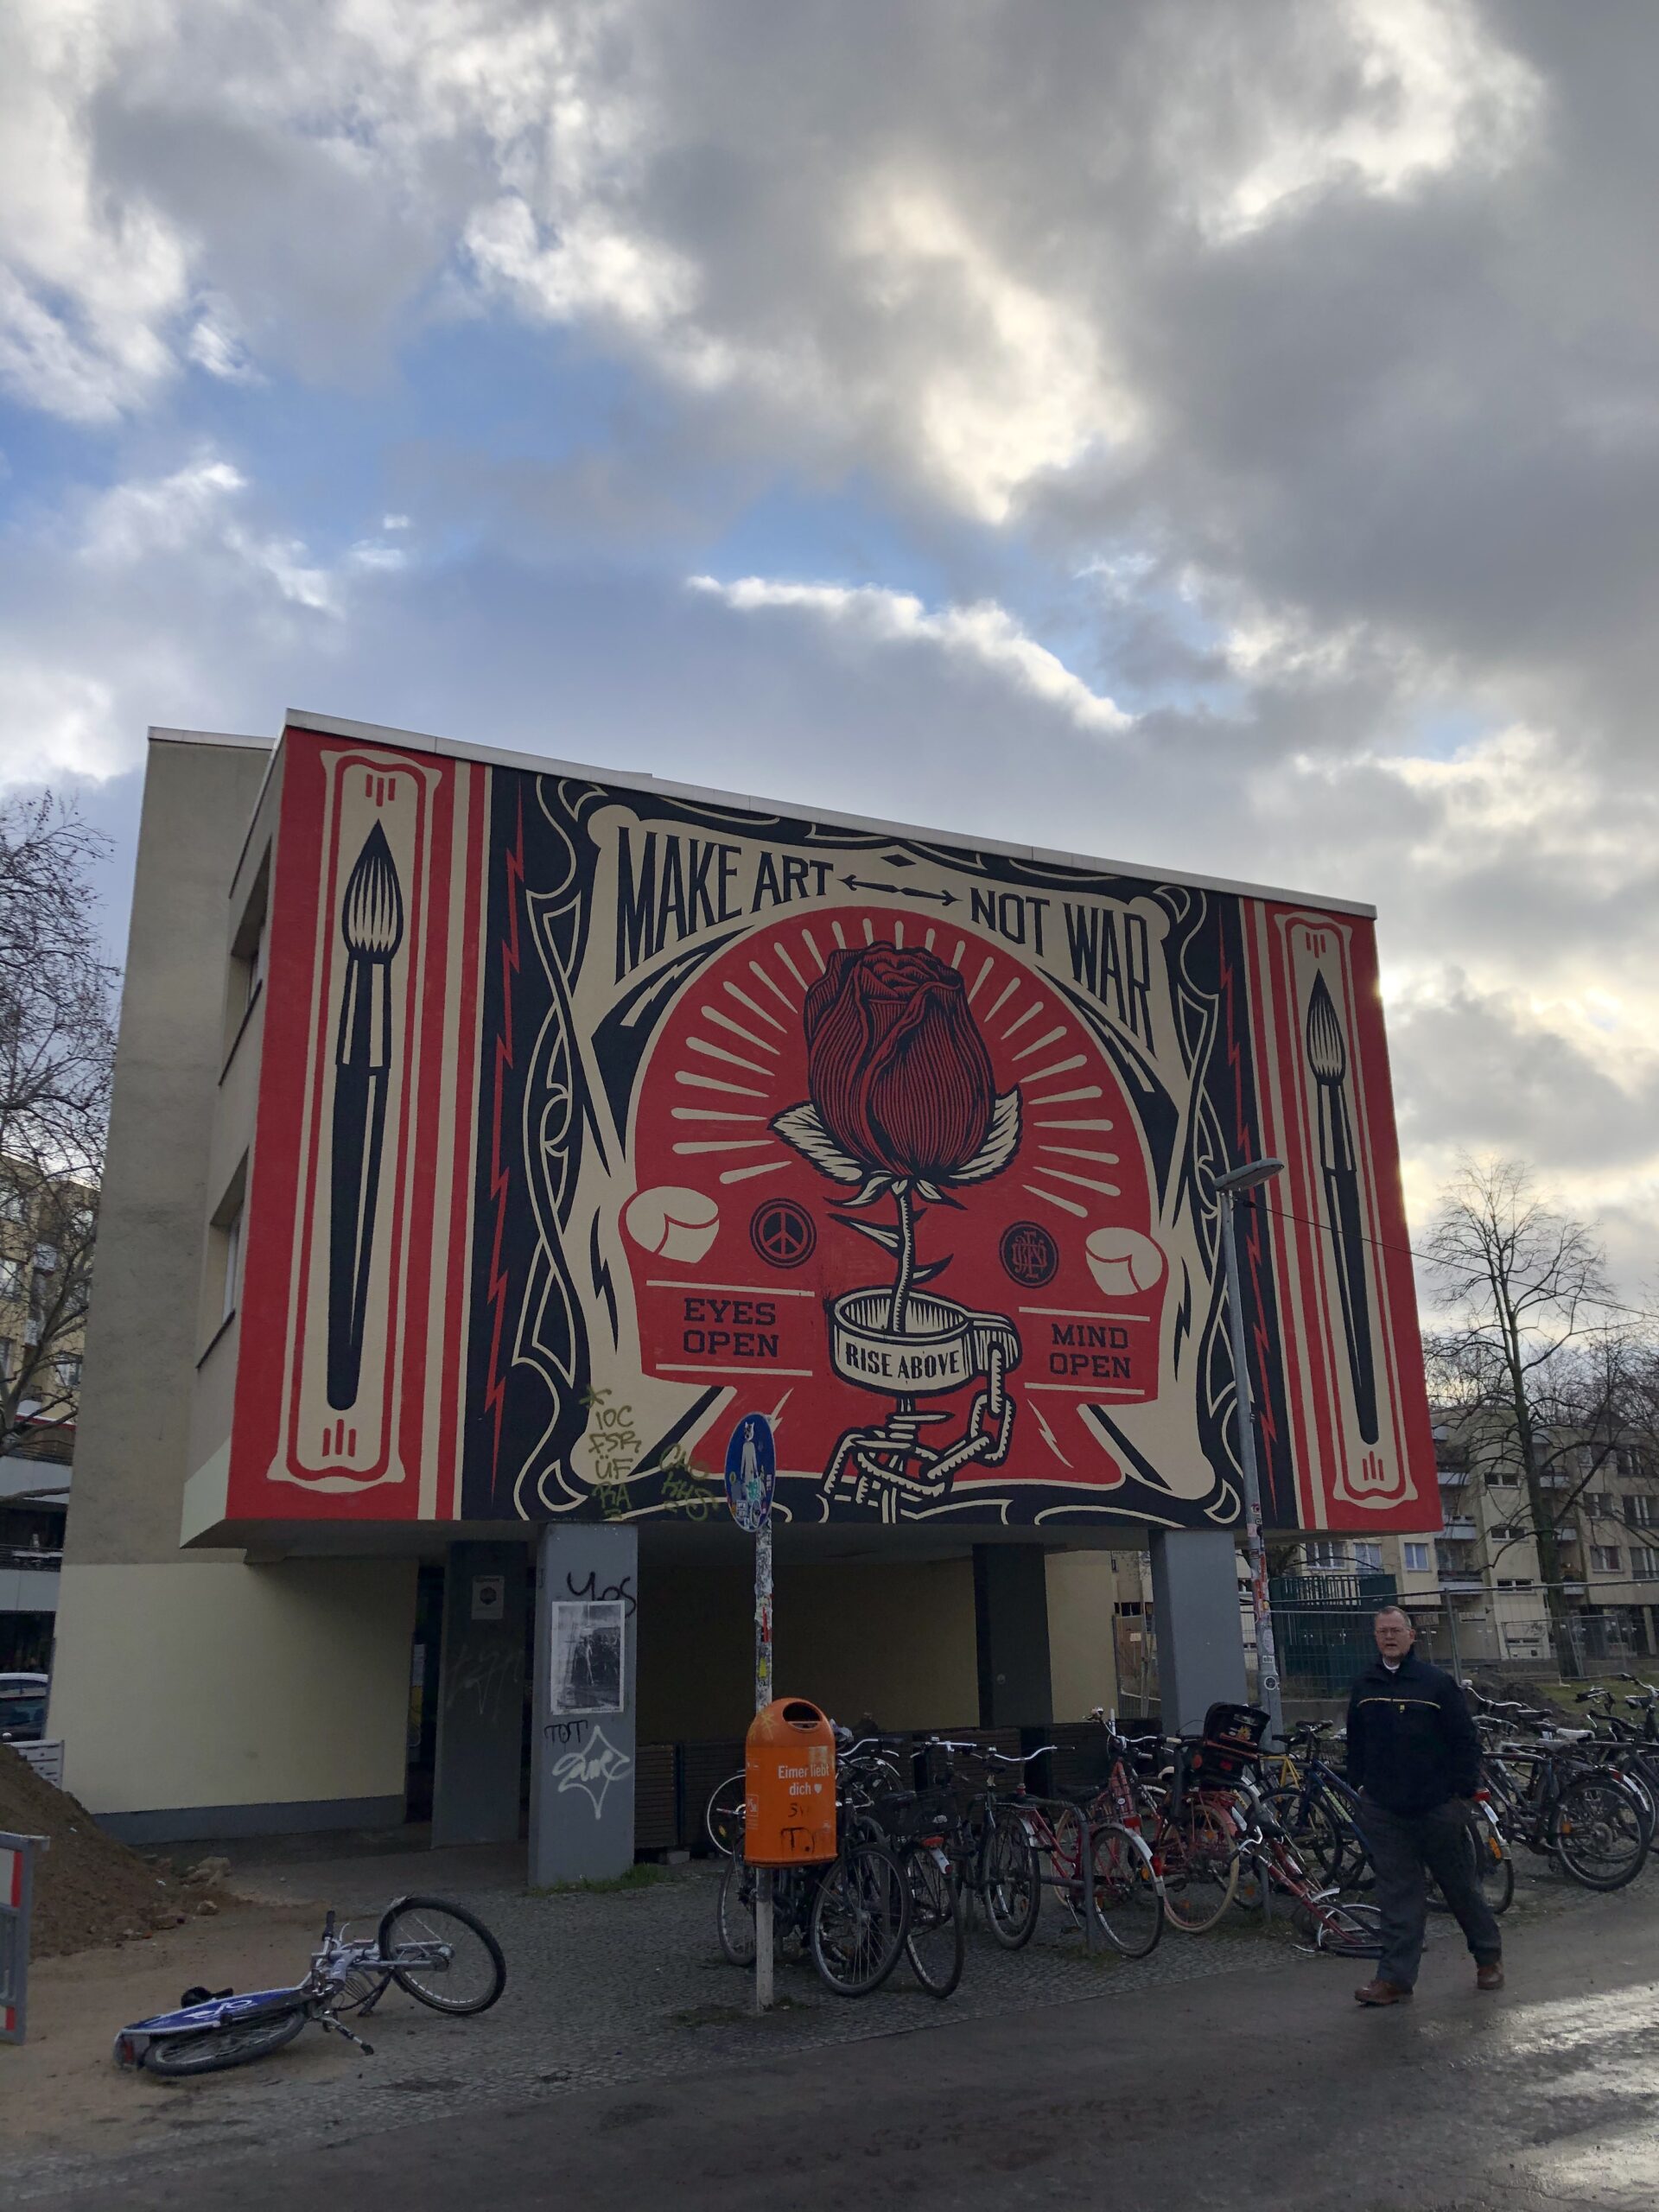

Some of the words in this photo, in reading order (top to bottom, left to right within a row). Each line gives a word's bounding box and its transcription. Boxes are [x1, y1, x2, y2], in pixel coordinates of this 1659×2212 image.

[614, 826, 742, 986] MAKE
[750, 850, 834, 914] ART
[969, 887, 1051, 957] NOT
[1062, 901, 1159, 1062] WAR
[683, 1297, 777, 1326] EYES
[683, 1329, 779, 1358] OPEN
[1051, 1323, 1129, 1350] MIND
[845, 1341, 893, 1378] RISE
[897, 1350, 960, 1380] ABOVE
[1049, 1352, 1132, 1379] OPEN
[779, 1764, 809, 1779] Eimer
[810, 1763, 830, 1777] liebt
[789, 1782, 812, 1796] dich
